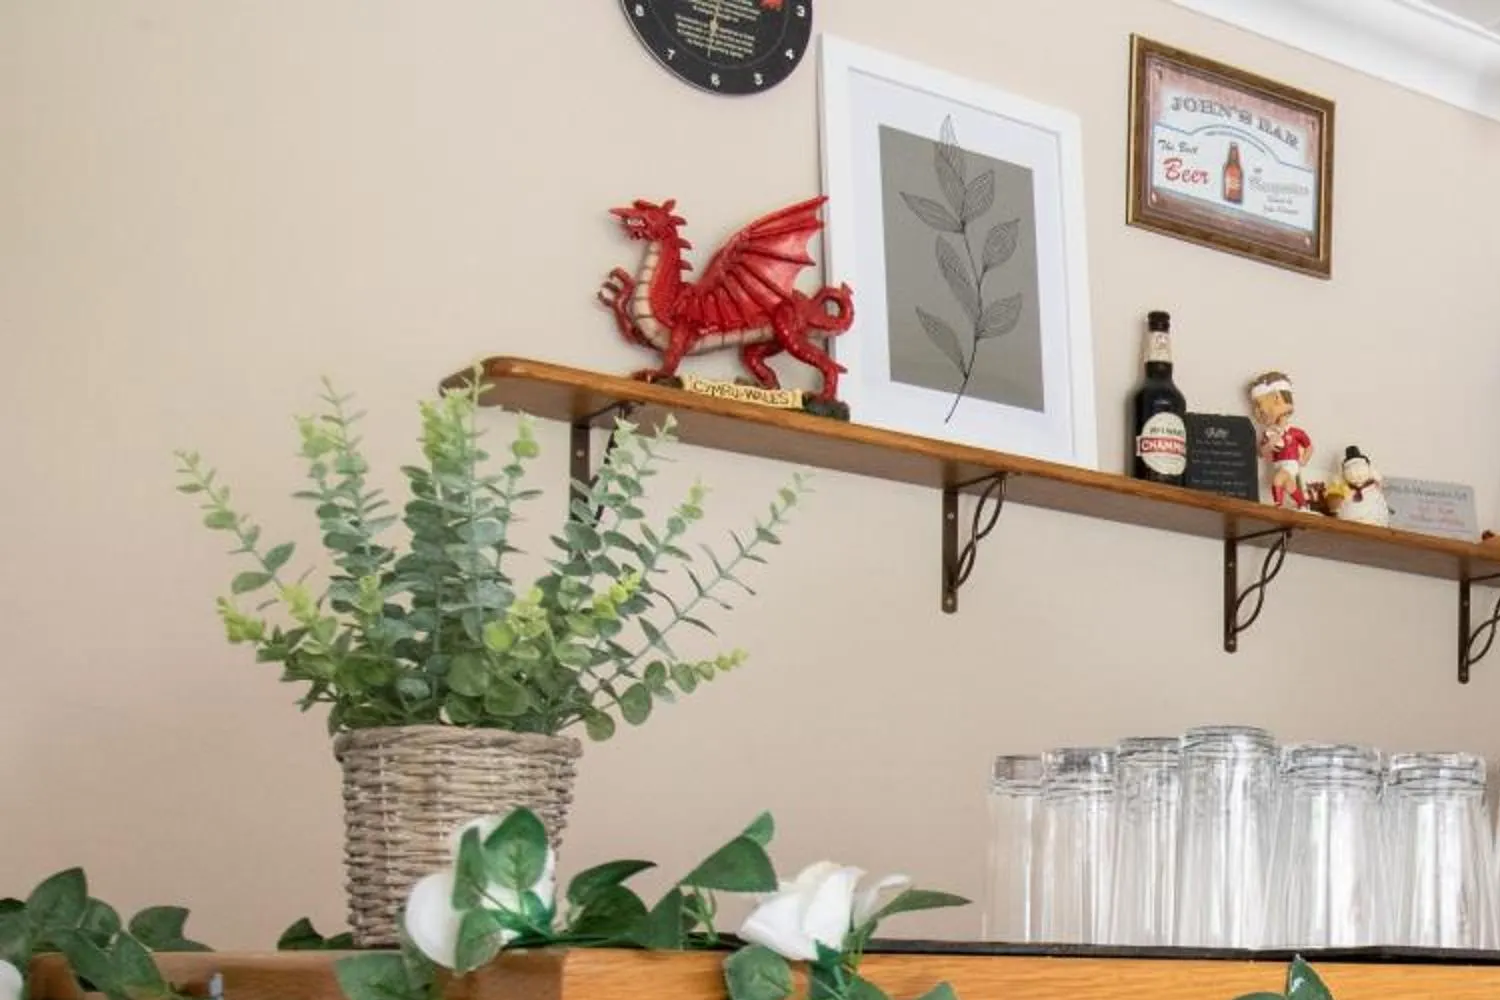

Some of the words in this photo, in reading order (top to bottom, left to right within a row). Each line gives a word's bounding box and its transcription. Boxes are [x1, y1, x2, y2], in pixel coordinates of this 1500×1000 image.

[796, 5, 806, 17] 3
[667, 47, 676, 60] 7
[785, 47, 795, 60] 4
[1172, 96, 1253, 125] JOHN'S
[1256, 115, 1299, 150] BAR
[1163, 157, 1209, 185] Beer
